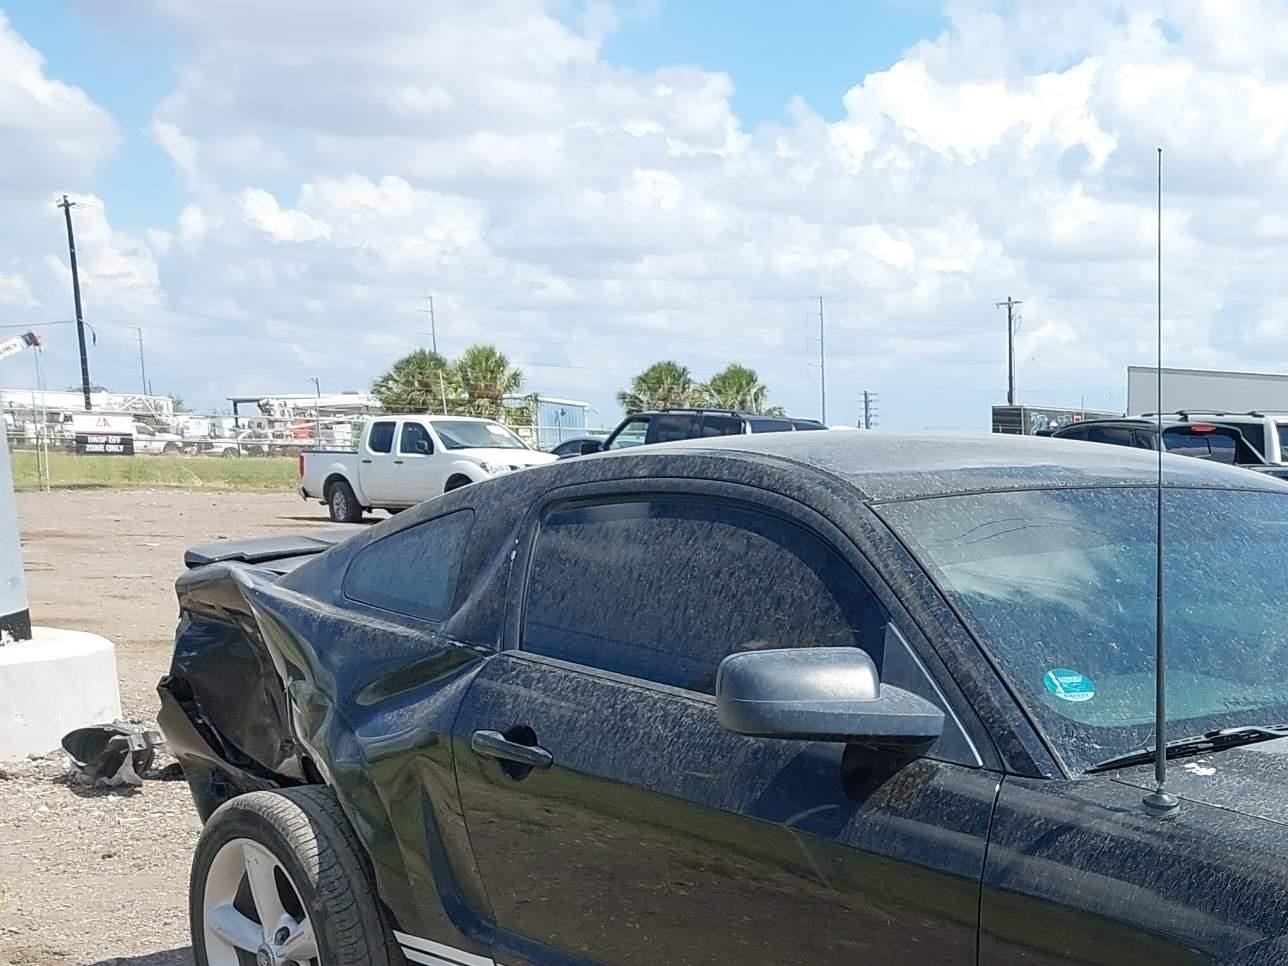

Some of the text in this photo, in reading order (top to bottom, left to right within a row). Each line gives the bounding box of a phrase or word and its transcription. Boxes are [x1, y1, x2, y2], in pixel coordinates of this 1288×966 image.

[87, 436, 121, 444] DROP OFF
[86, 444, 124, 452] ZONE ONLY
